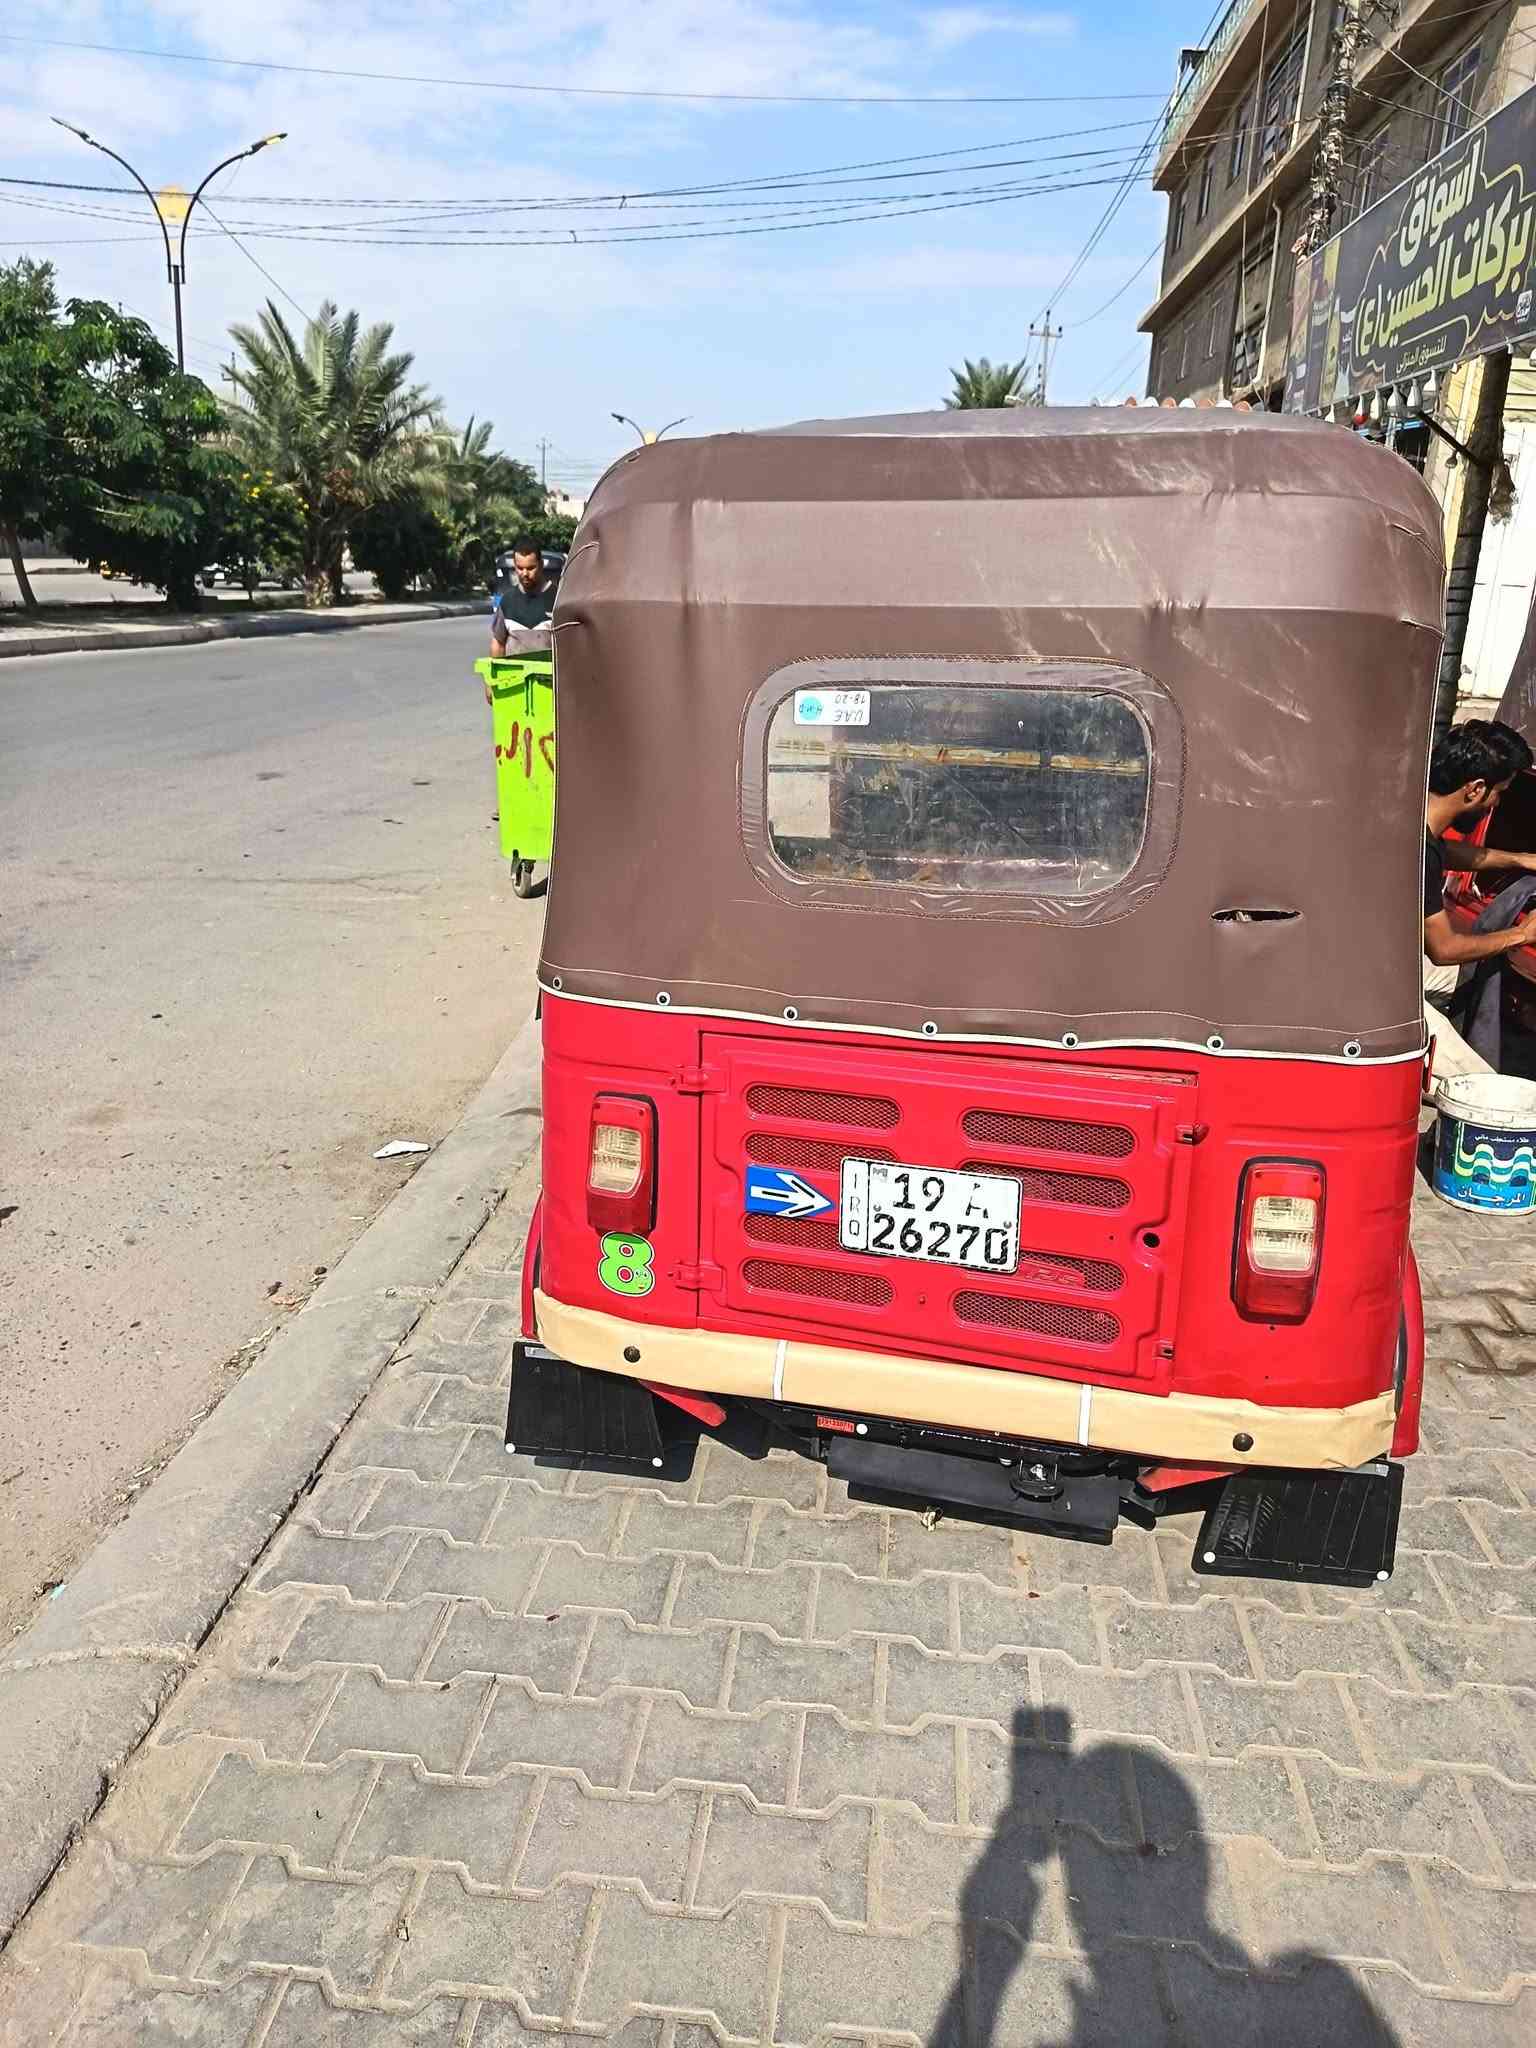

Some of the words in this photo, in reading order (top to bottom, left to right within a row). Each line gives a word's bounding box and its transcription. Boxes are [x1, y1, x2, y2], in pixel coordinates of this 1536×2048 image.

[1399, 139, 1481, 268] اسواق
[1451, 185, 1533, 299] بركات
[1378, 233, 1455, 348] الحسين
[893, 1172, 945, 1212] 19
[597, 1230, 656, 1298] 8
[872, 1212, 1009, 1265] 26270
